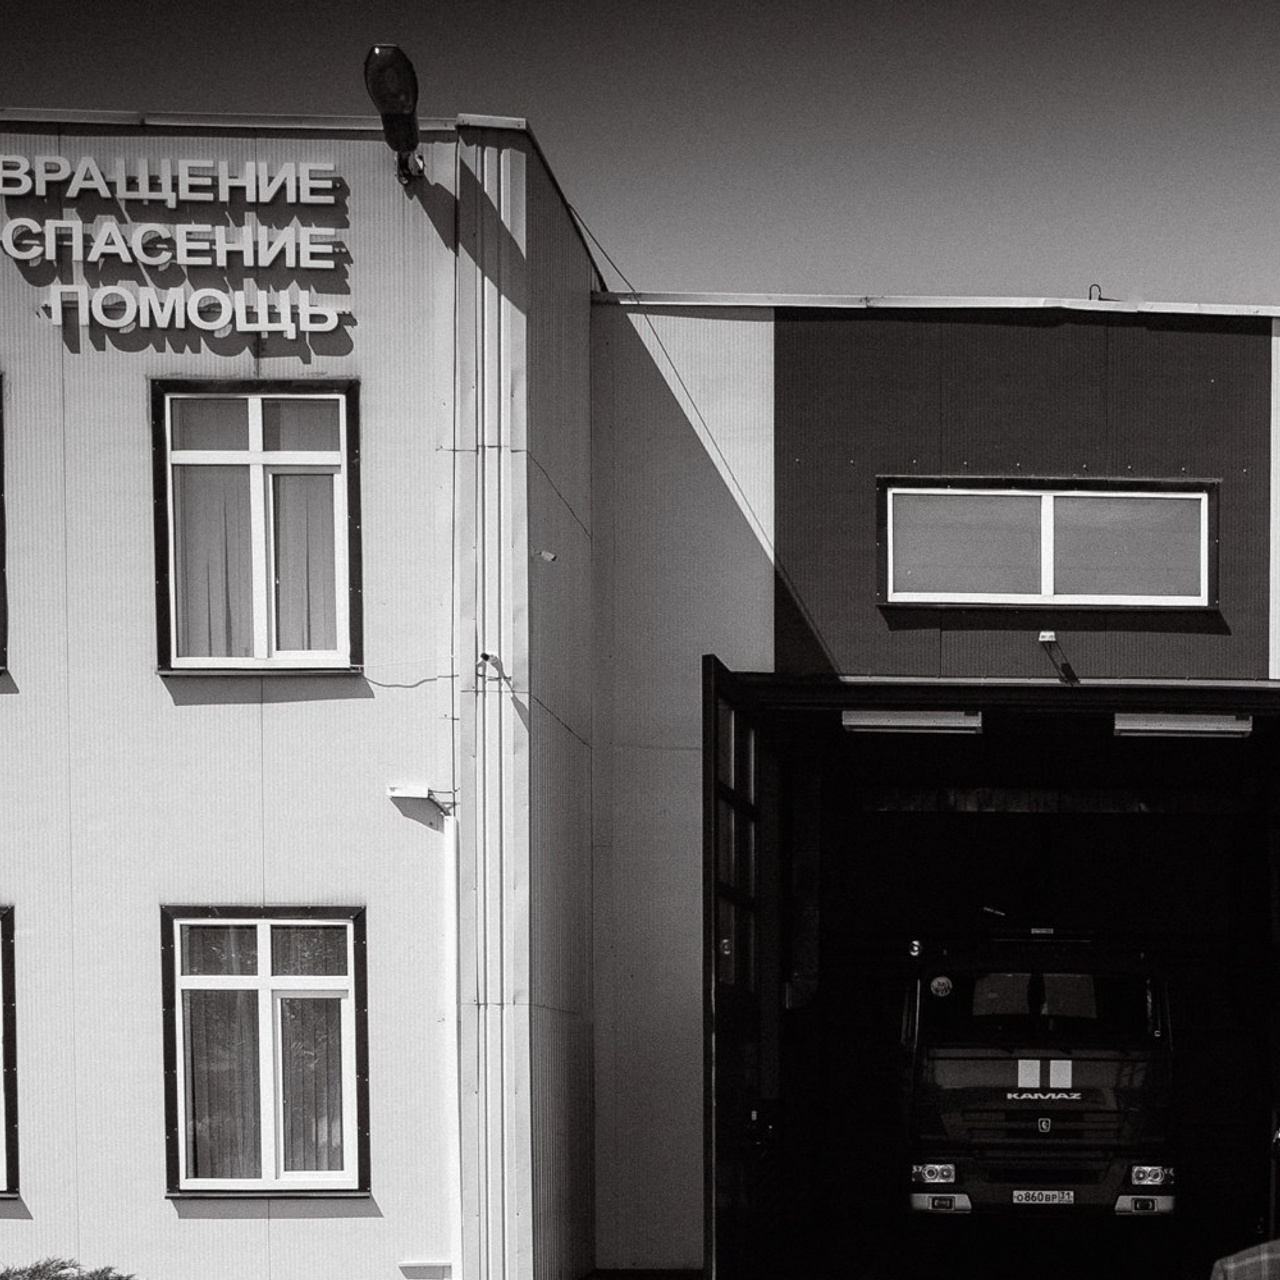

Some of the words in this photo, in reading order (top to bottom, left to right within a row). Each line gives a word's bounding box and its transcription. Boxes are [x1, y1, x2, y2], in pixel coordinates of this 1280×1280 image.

[0, 155, 336, 209] ВРАЩЕНИЕ
[1, 217, 336, 269] СПАСЕНИЕ
[51, 285, 339, 340] ПОМОЩЬ
[1006, 1092, 1082, 1100] KAMAZ
